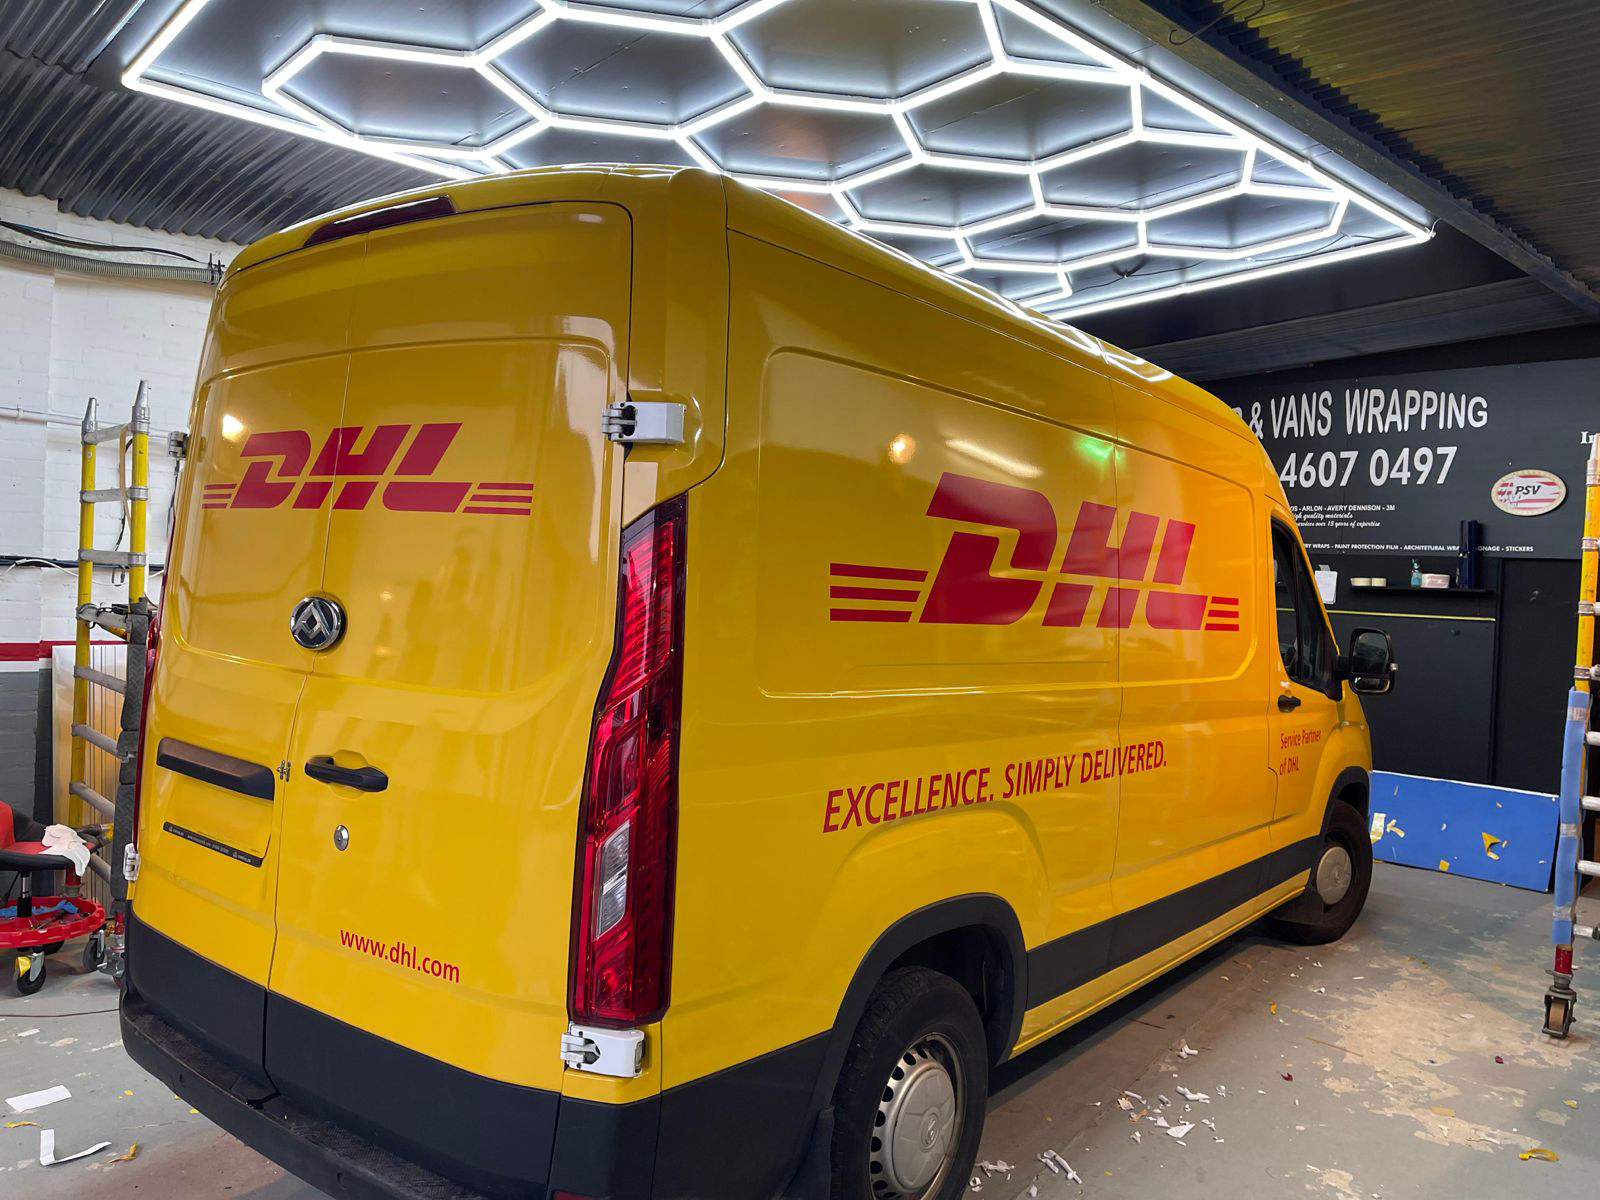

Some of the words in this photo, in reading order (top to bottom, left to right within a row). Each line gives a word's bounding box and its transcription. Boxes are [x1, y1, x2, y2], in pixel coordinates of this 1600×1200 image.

[1270, 390, 1333, 439] VANS
[1345, 388, 1488, 435] WRAPPING
[230, 423, 463, 513] DHL
[1279, 450, 1359, 488] 4607
[1369, 446, 1458, 487] 0497
[1327, 504, 1348, 512] AVERY
[1514, 485, 1542, 496] PSV
[919, 472, 1208, 631] DHL
[1280, 731, 1301, 750] Service
[1301, 729, 1321, 745] Partner
[823, 767, 994, 834] EXCELLENCE.
[1002, 754, 1076, 800] SIMPLY
[1080, 740, 1168, 784] DELIVERED.
[1279, 757, 1288, 776] of
[1287, 756, 1299, 774] DHL
[340, 929, 460, 983] www.dhl.com
